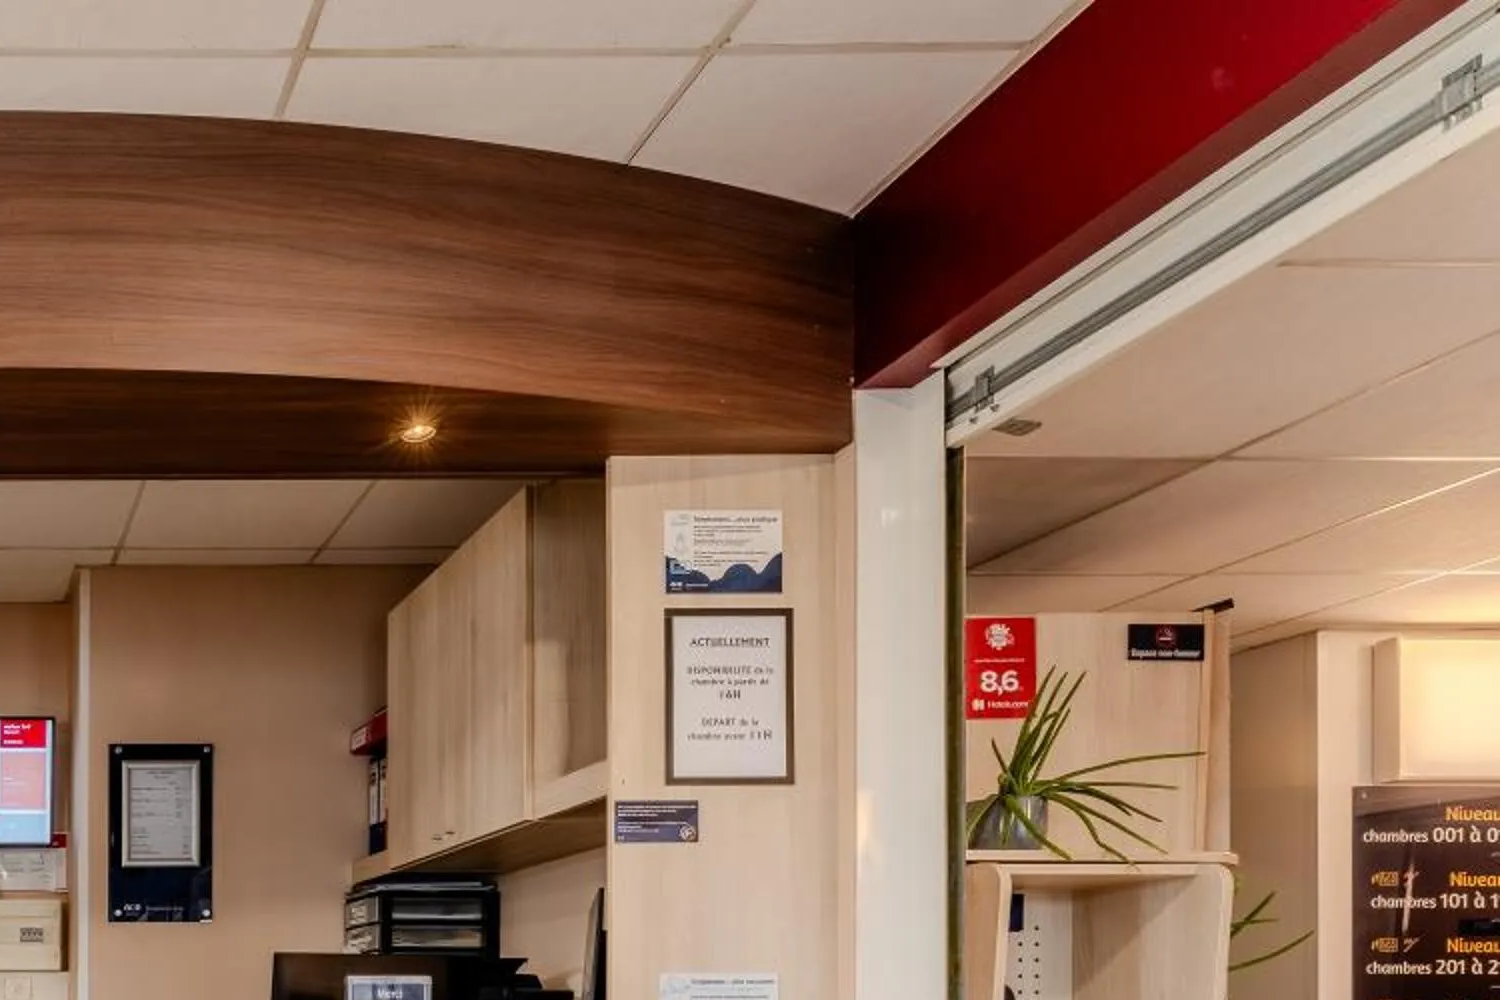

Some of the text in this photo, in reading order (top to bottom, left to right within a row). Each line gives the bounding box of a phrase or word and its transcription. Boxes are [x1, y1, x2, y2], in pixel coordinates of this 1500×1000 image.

[689, 637, 771, 648] ACTUELLEMENT
[980, 670, 1019, 695] 8,6
[1362, 828, 1429, 843] chambres
[1432, 827, 1464, 843] 001
[1470, 825, 1482, 843] à
[1440, 893, 1468, 909] 101
[1473, 891, 1485, 909] à
[1365, 960, 1432, 975] chambres
[1435, 959, 1465, 975] 201
[1471, 957, 1483, 975] à
